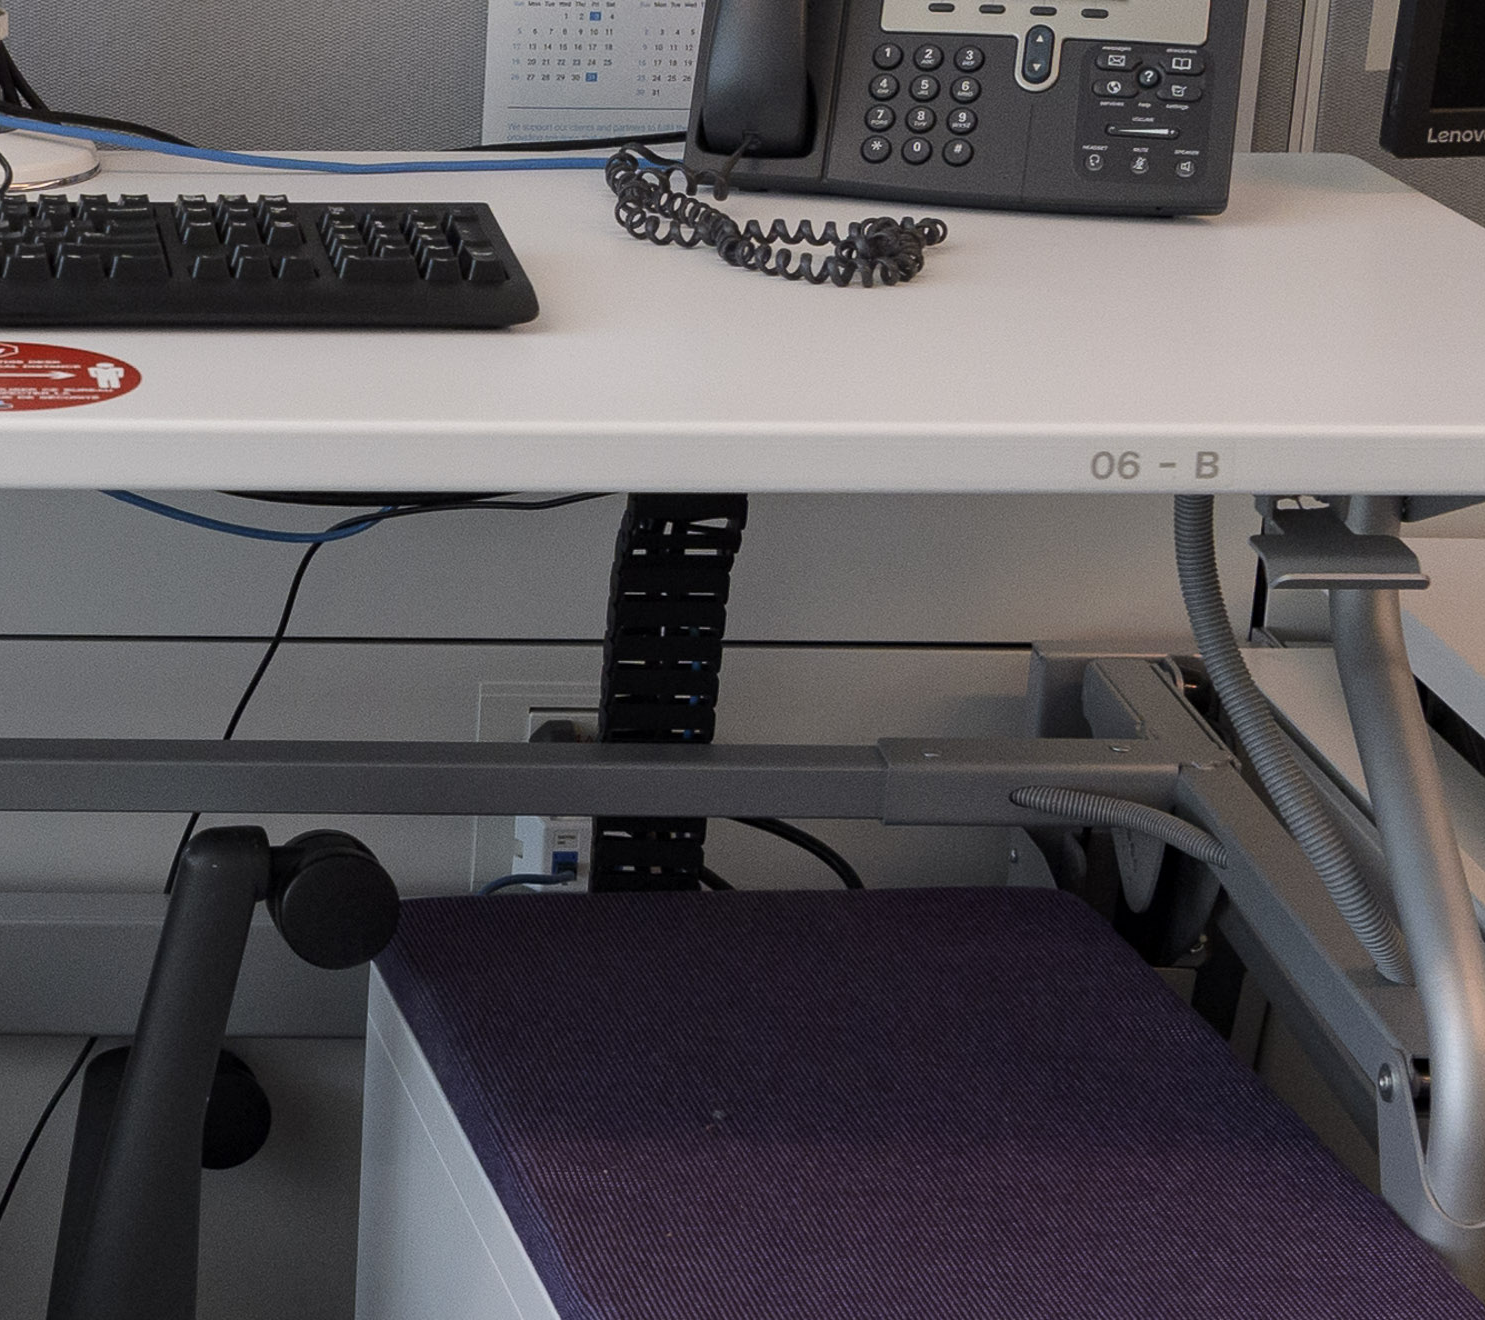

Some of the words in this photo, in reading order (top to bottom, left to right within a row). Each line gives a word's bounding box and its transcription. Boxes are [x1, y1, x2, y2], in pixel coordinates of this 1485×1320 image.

[884, 47, 891, 58] 1
[924, 49, 933, 59] 2
[966, 50, 974, 61] 3
[879, 79, 888, 89] 4
[921, 80, 929, 90] 5
[961, 81, 970, 91] 6
[877, 109, 885, 119] 7
[917, 111, 925, 121] 8
[958, 112, 967, 122] 9
[913, 142, 921, 152] 0
[1091, 451, 1140, 480] 06
[1196, 451, 1219, 479] B
